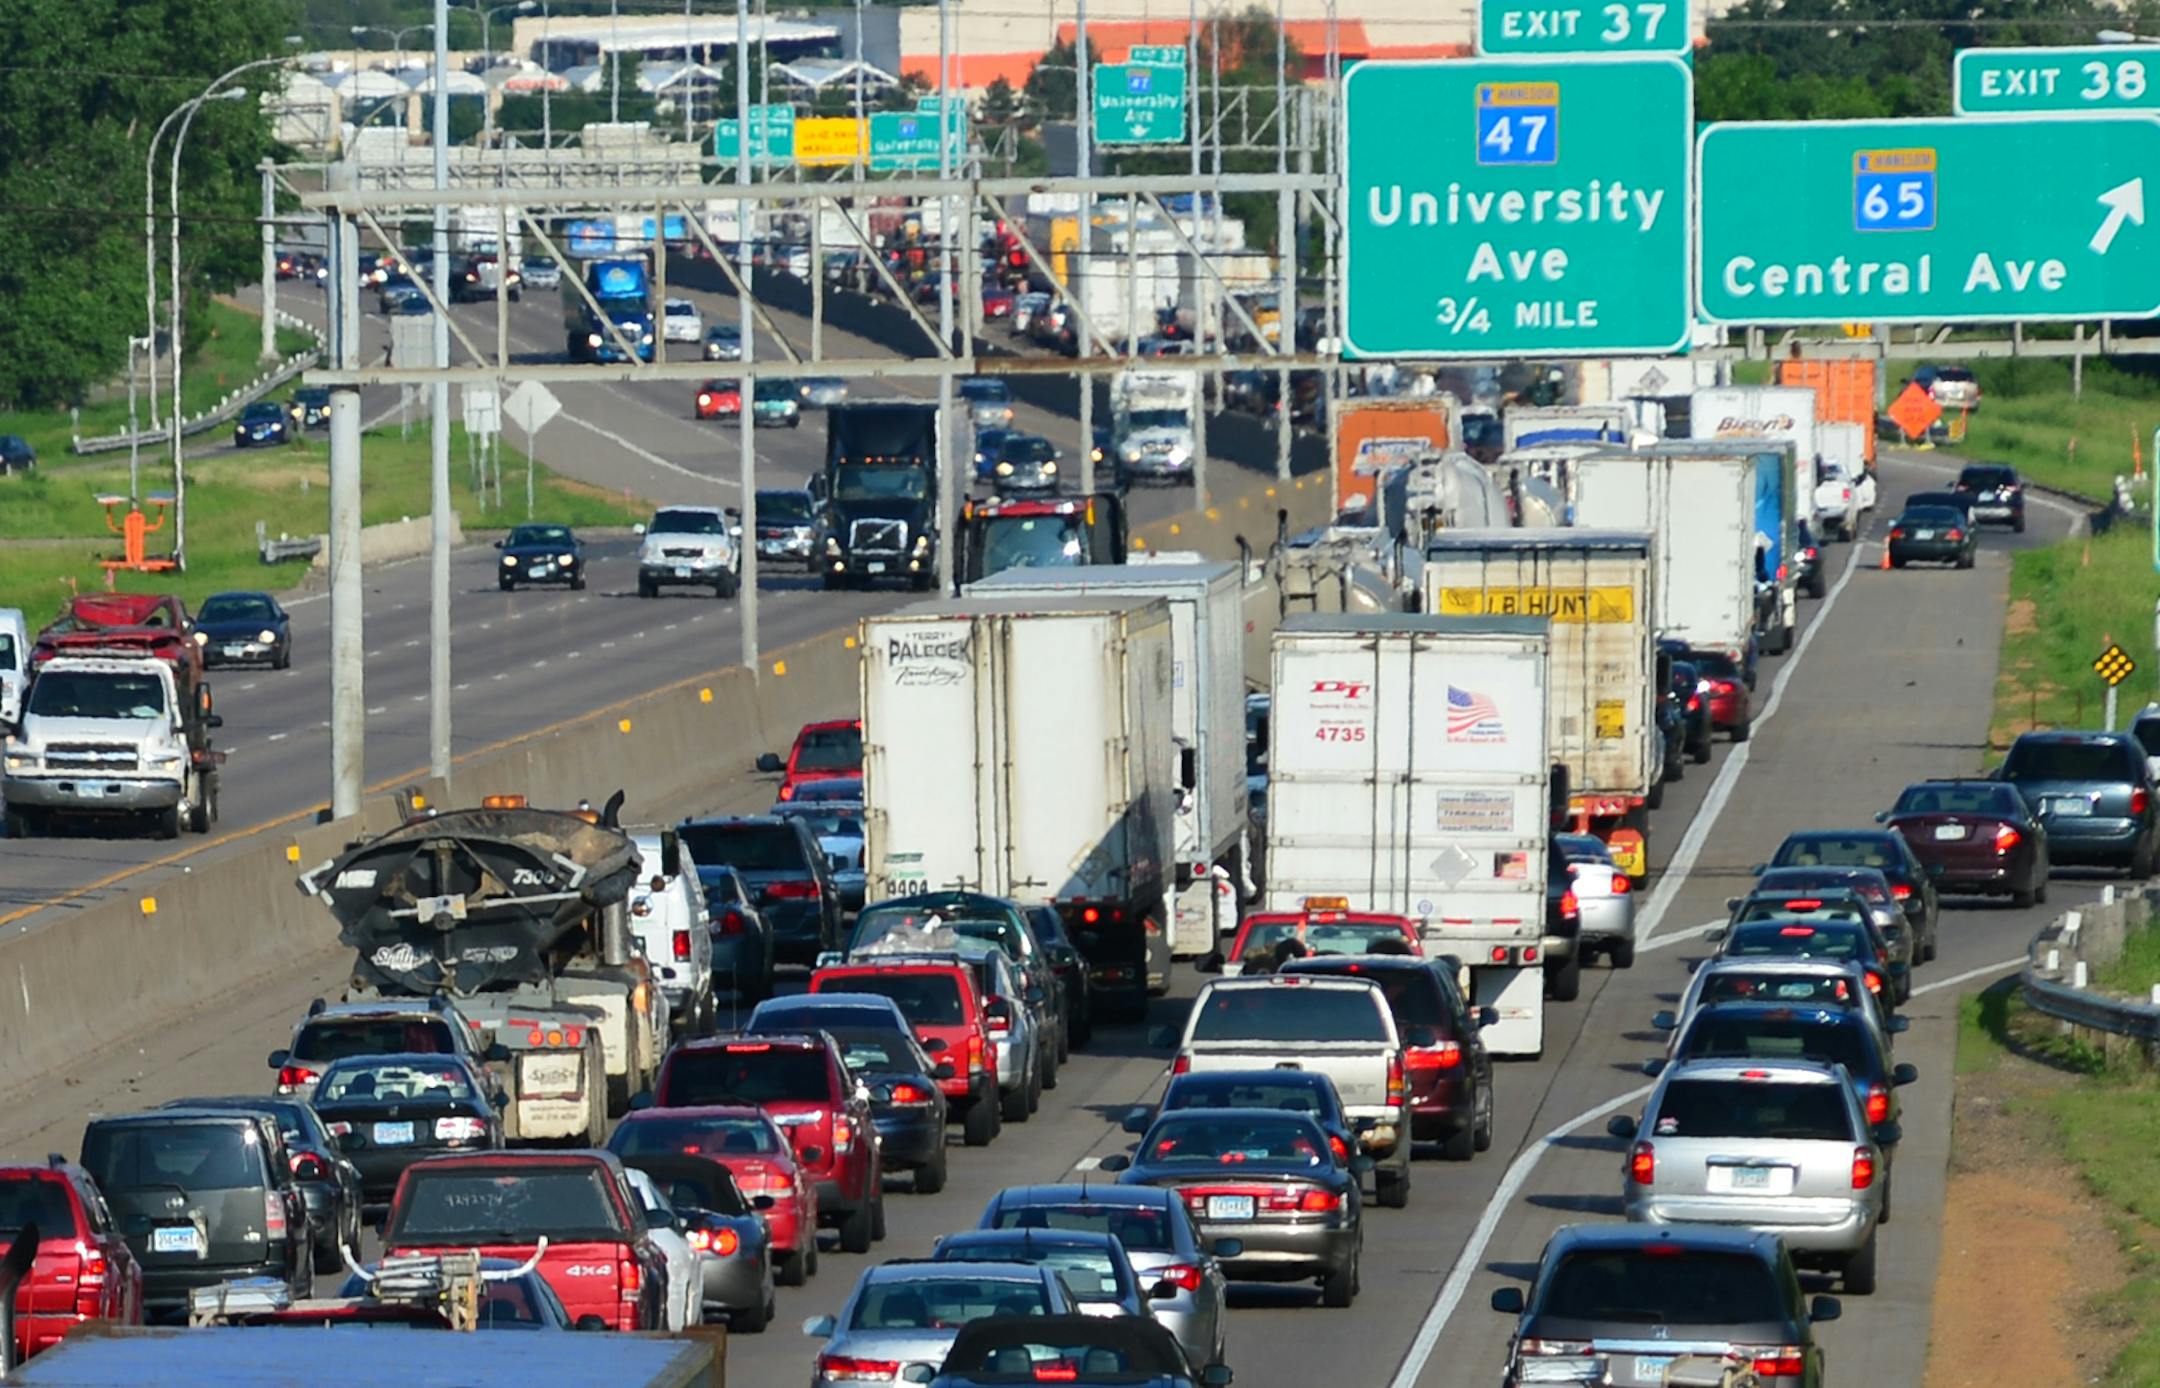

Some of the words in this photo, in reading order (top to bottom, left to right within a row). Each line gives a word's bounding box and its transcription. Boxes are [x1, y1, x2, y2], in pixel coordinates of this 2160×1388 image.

[1502, 10, 1582, 39] EXIT
[1601, 3, 1667, 43] 37
[1980, 68, 2061, 97] EXIT
[2080, 60, 2146, 100] 38
[1100, 94, 1179, 109] University
[1484, 116, 1548, 155] 47
[1368, 180, 1664, 231] University
[1862, 181, 1926, 220] 65
[1466, 242, 1569, 282] Ave
[1723, 254, 1931, 297] Central
[1963, 252, 2068, 292] Ave
[1436, 297, 1492, 334] 3/4
[1515, 301, 1599, 328] MILE
[1528, 594, 1592, 616] HUNT
[1316, 727, 1366, 742] 4735
